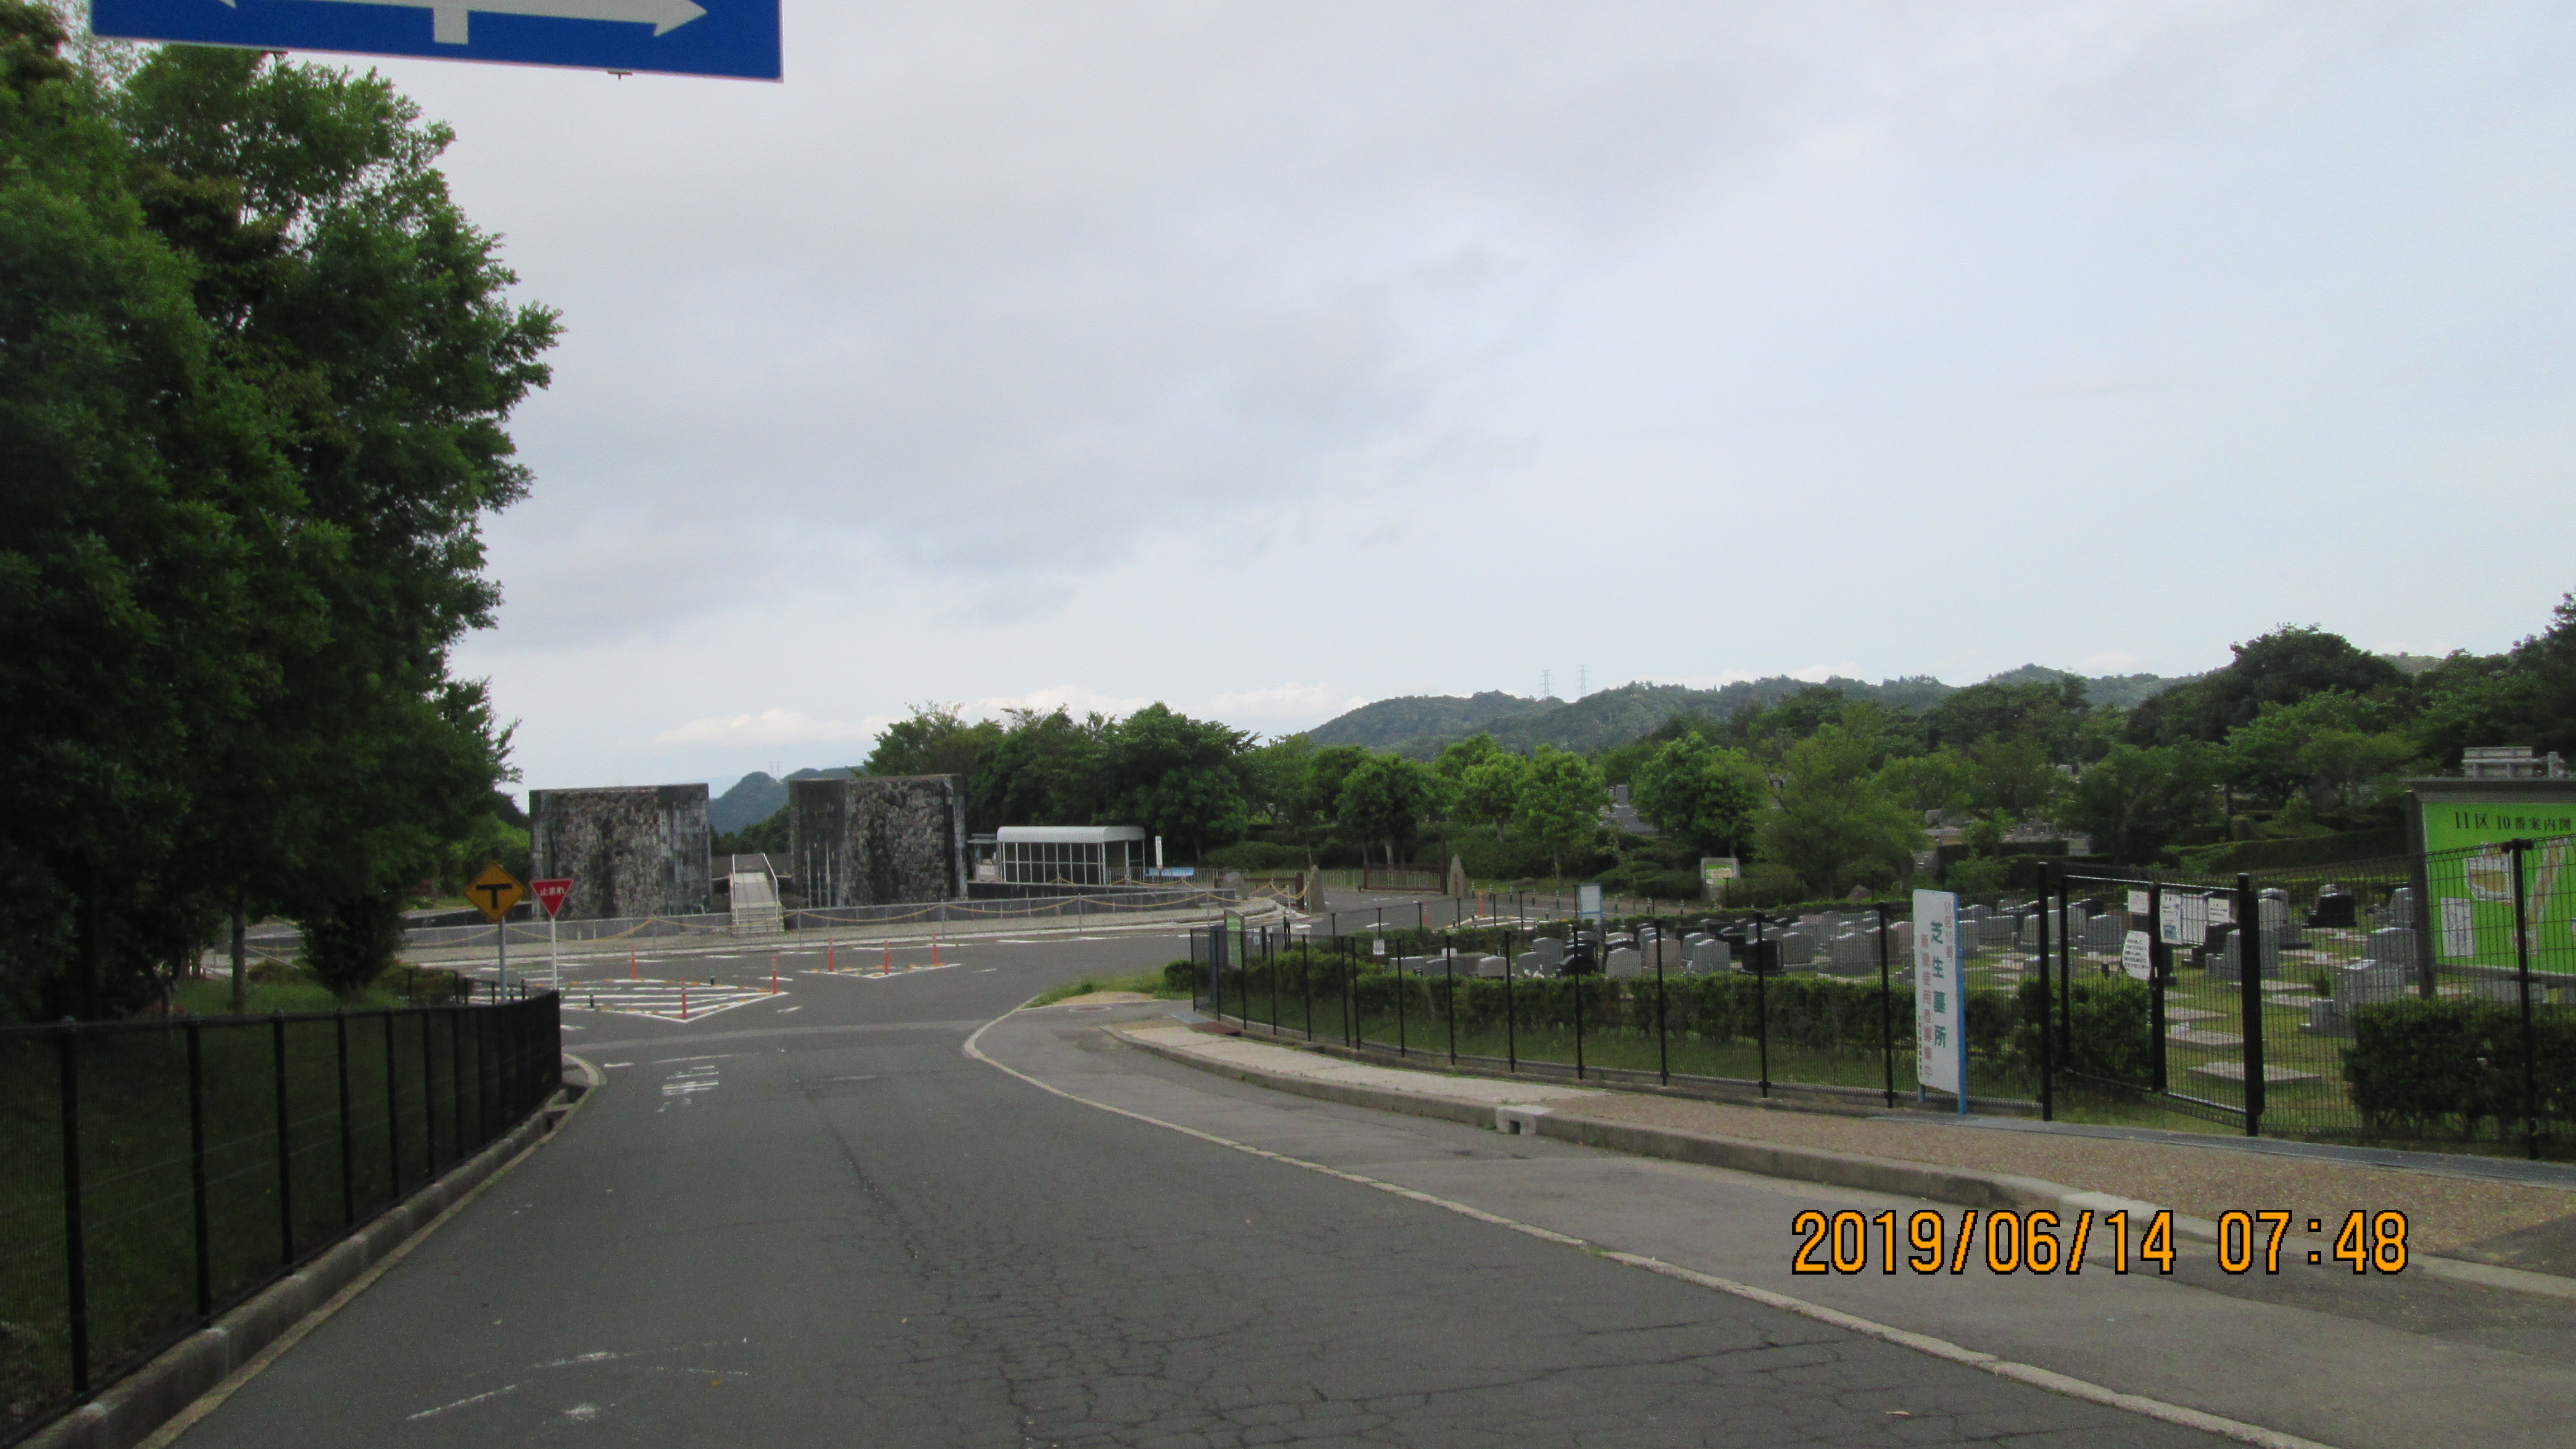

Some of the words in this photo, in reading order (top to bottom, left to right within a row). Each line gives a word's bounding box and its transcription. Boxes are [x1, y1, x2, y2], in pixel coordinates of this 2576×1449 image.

[540, 887, 565, 896] 止まれ
[1930, 921, 1947, 1049] 芝生墓所
